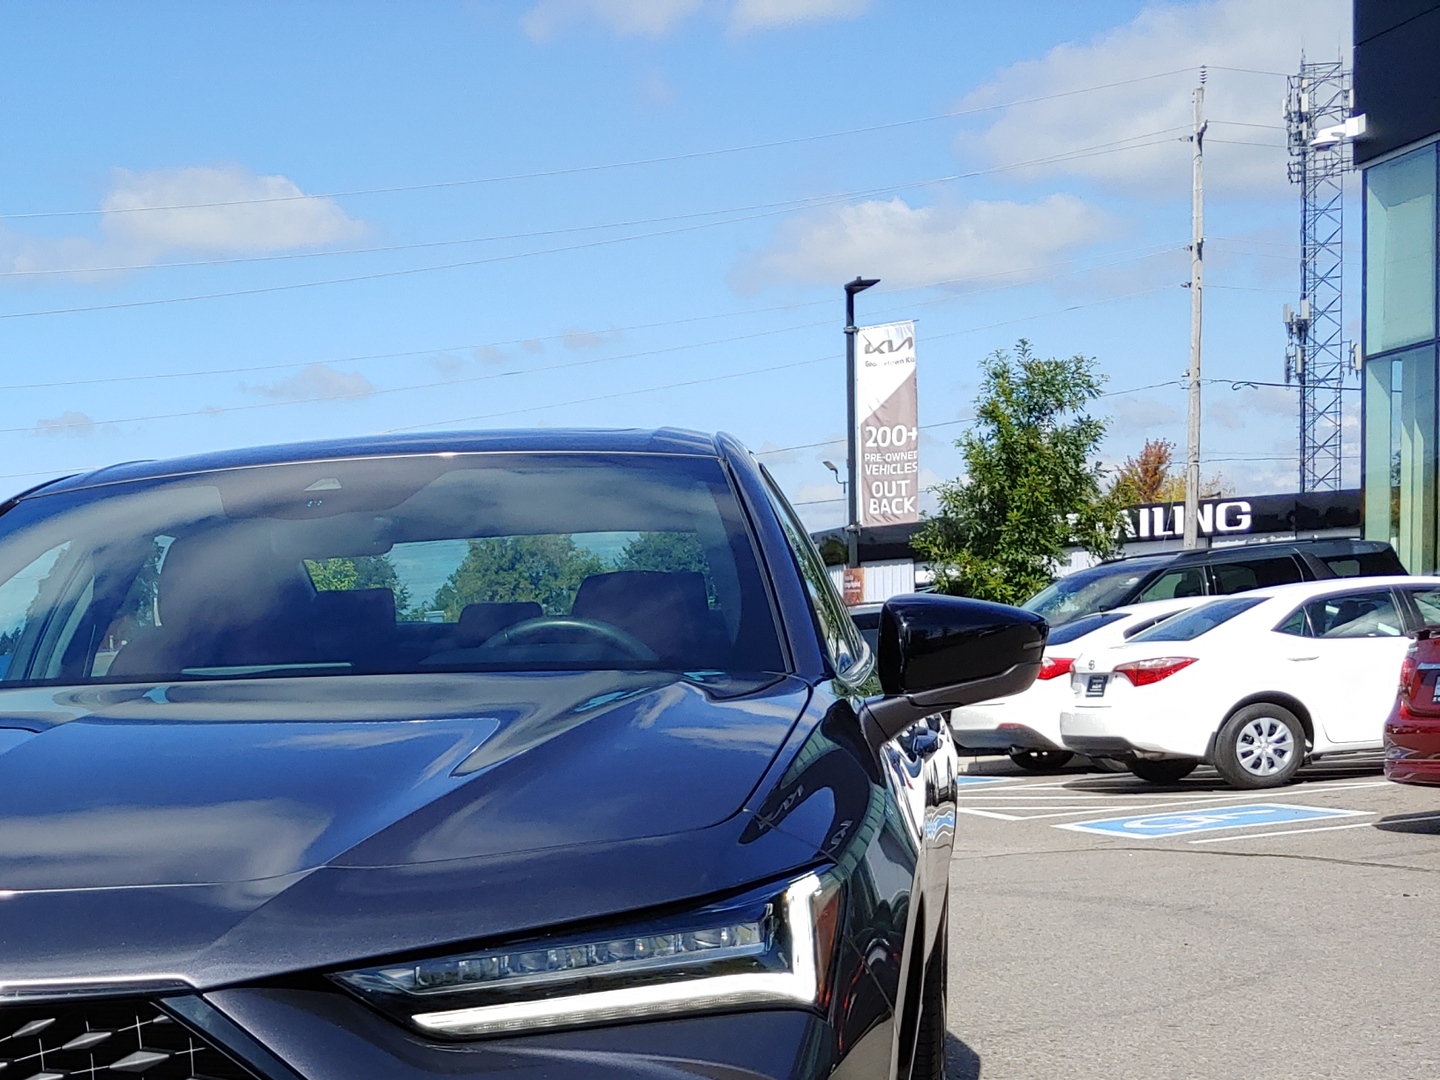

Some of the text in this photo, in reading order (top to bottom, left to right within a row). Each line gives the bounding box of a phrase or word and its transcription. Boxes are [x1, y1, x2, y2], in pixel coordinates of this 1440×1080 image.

[864, 336, 913, 354] KIA
[865, 425, 918, 448] 200+
[864, 450, 918, 462] PRE-OWNED
[865, 461, 918, 475] VEHICLES
[871, 480, 910, 498] OUT
[869, 496, 916, 515] BACK
[1052, 501, 1252, 542] AILING
